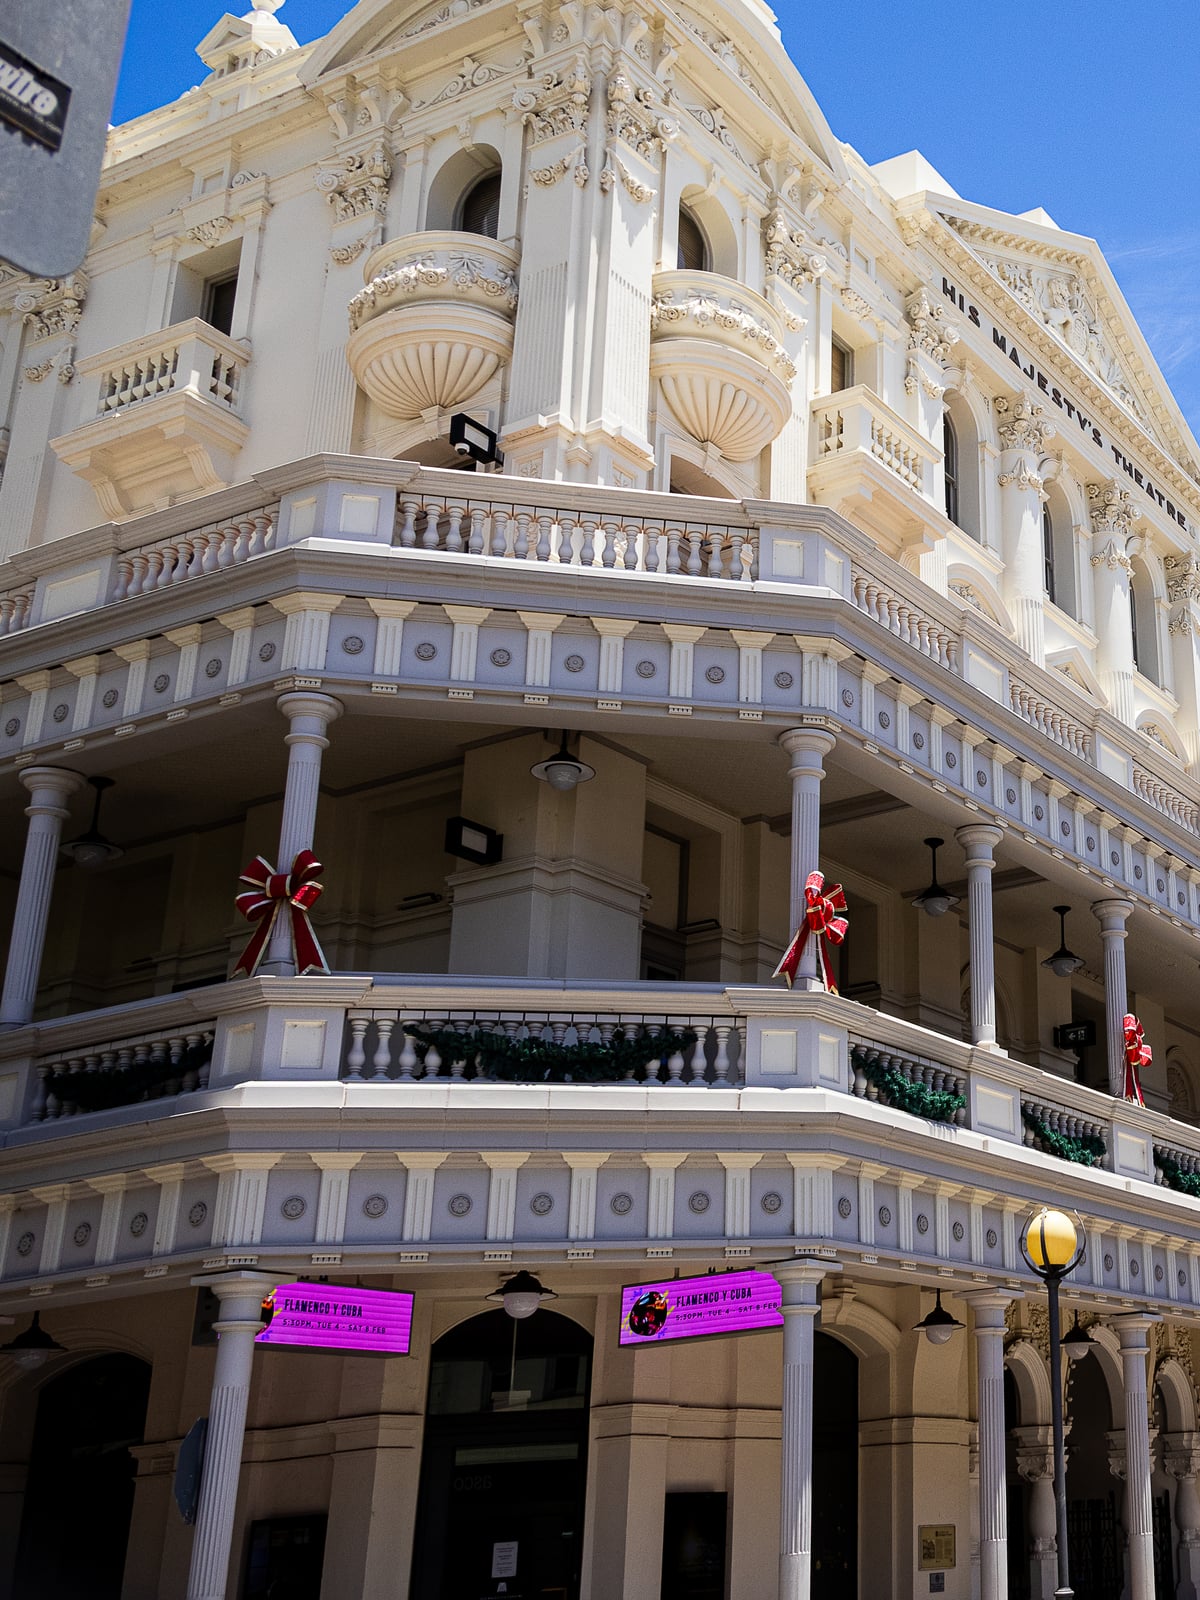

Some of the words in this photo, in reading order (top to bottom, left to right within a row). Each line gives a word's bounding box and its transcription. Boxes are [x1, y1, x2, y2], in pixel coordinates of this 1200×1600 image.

[942, 277, 980, 328] HIS
[992, 327, 1103, 448] MAJESTY'S
[1111, 445, 1188, 531] THEATRE
[676, 1291, 720, 1308] FLAMENCO
[722, 1290, 728, 1301] Y
[730, 1288, 752, 1300] CUBA
[284, 1299, 330, 1314] FLAMENCO
[333, 1304, 339, 1315] Y
[341, 1304, 363, 1318] CUBA
[708, 1308, 722, 1316] TUE
